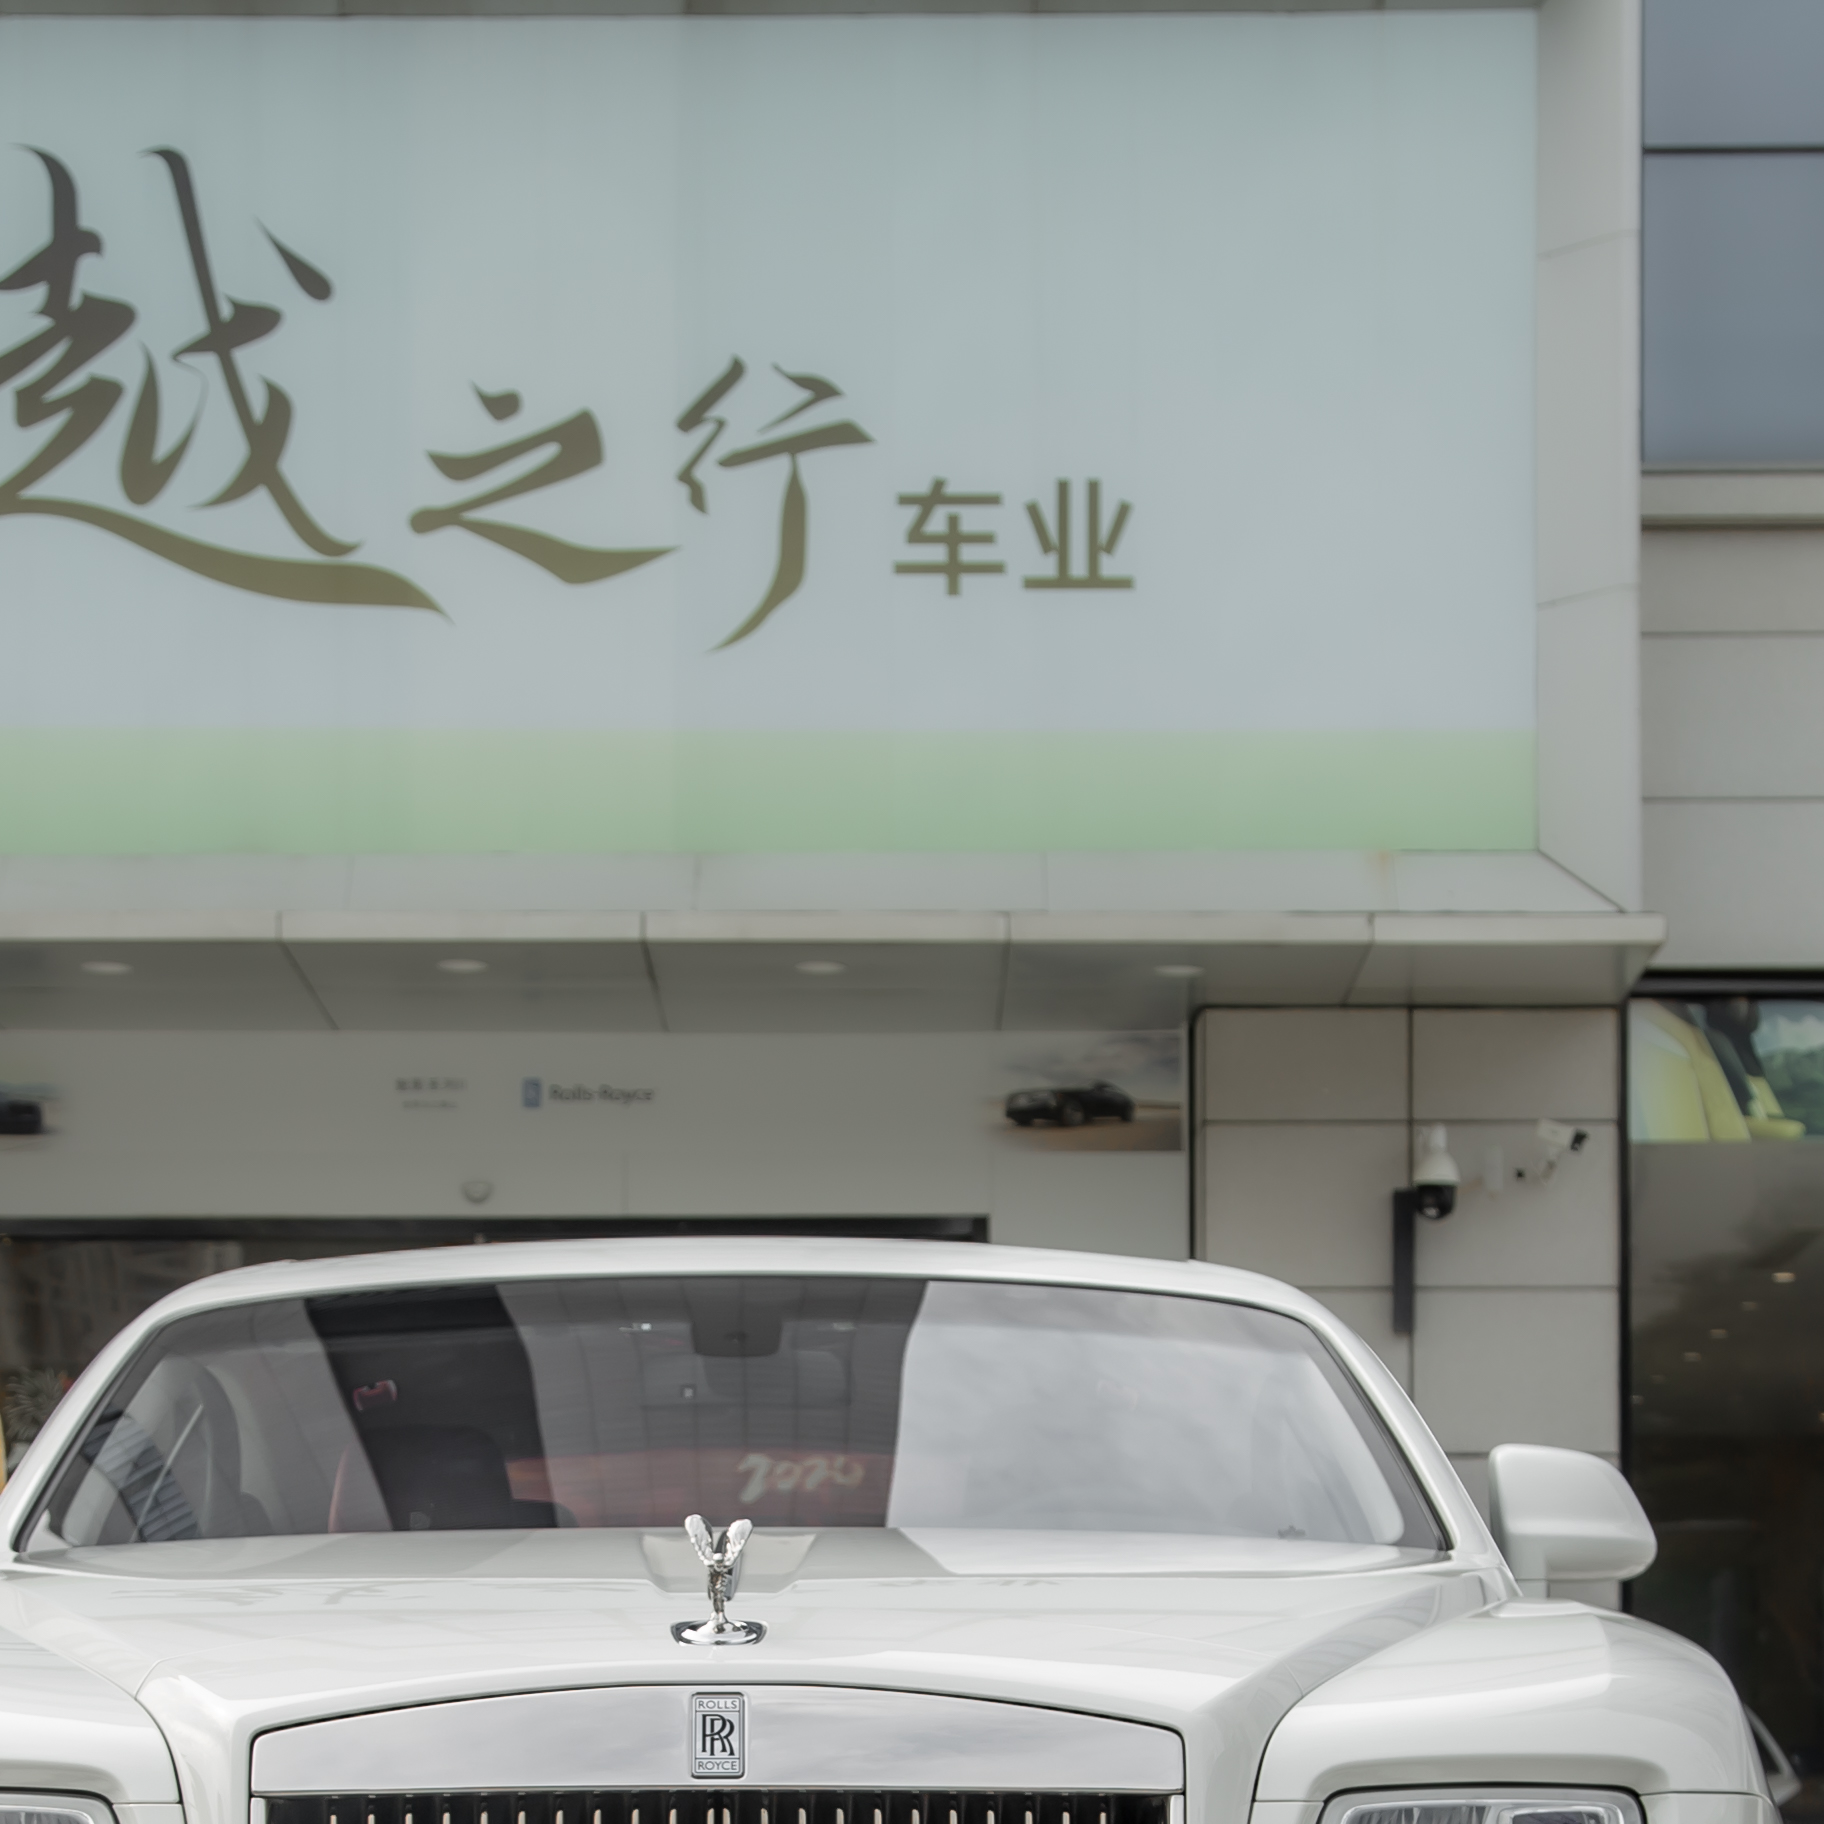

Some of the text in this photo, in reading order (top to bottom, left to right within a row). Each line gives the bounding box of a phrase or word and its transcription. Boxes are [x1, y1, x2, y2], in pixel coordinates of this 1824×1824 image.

[892, 477, 1135, 598] 车业
[698, 1700, 738, 1710] ROLLS
[701, 1713, 736, 1757] RR
[697, 1760, 738, 1771] ROYCE
